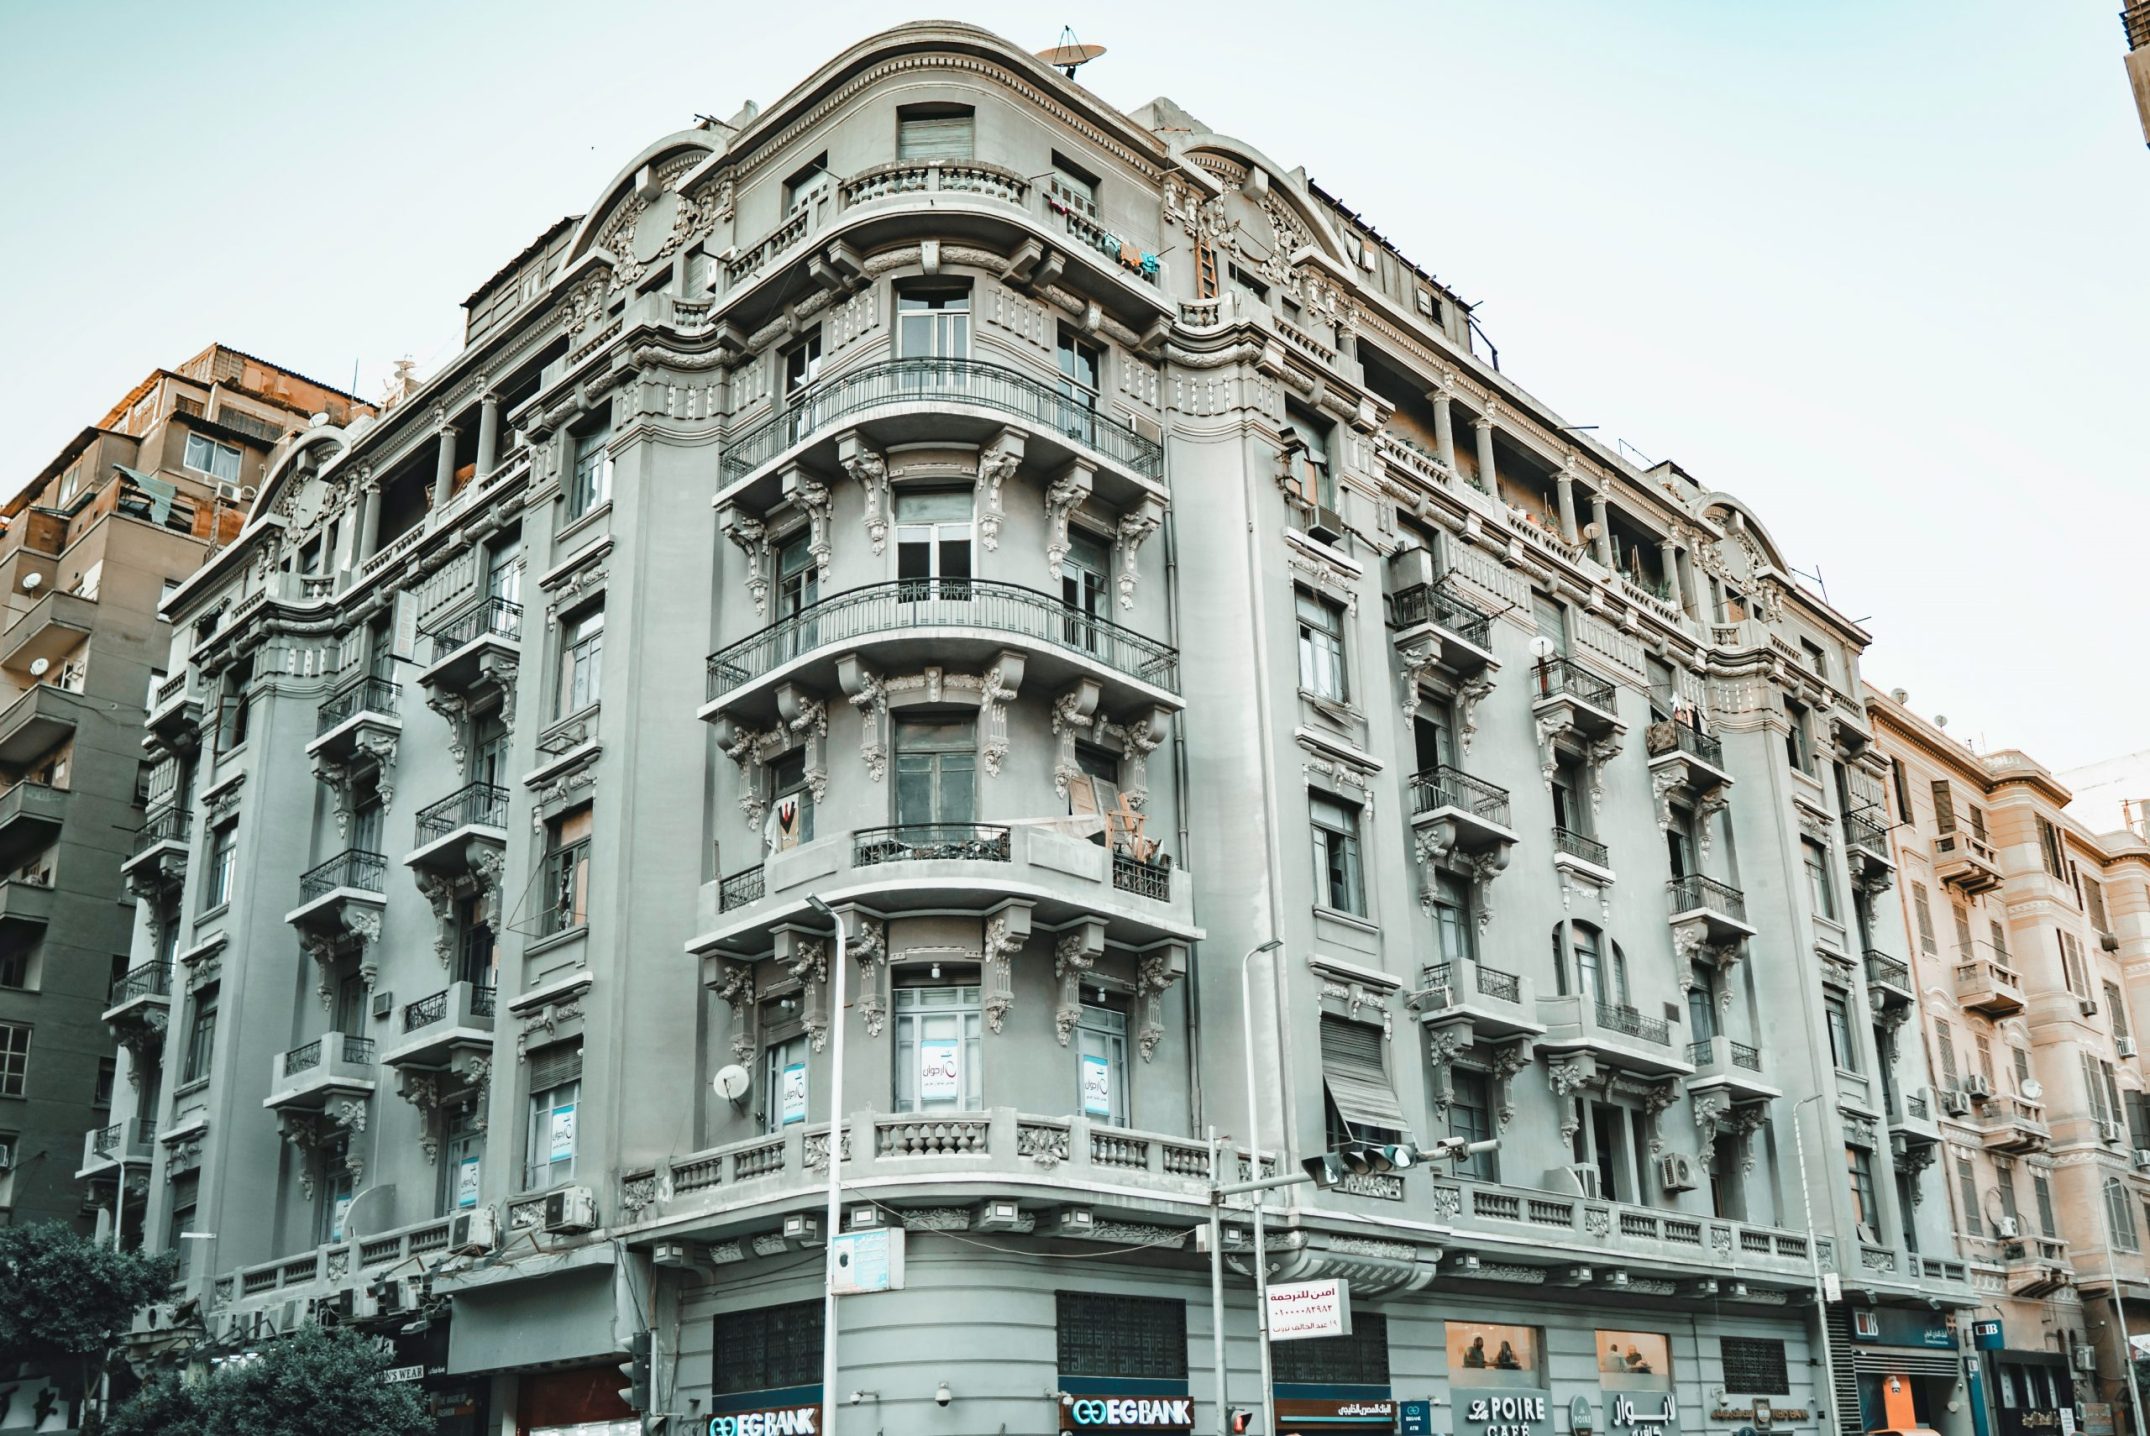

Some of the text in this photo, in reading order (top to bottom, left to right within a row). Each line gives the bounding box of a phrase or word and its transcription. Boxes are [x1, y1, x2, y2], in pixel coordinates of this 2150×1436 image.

[399, 1366, 423, 1379] WEAR
[1106, 1399, 1192, 1425] EGBANK
[1468, 1396, 1546, 1421] La POIRE
[737, 1407, 816, 1436] EGBANK
